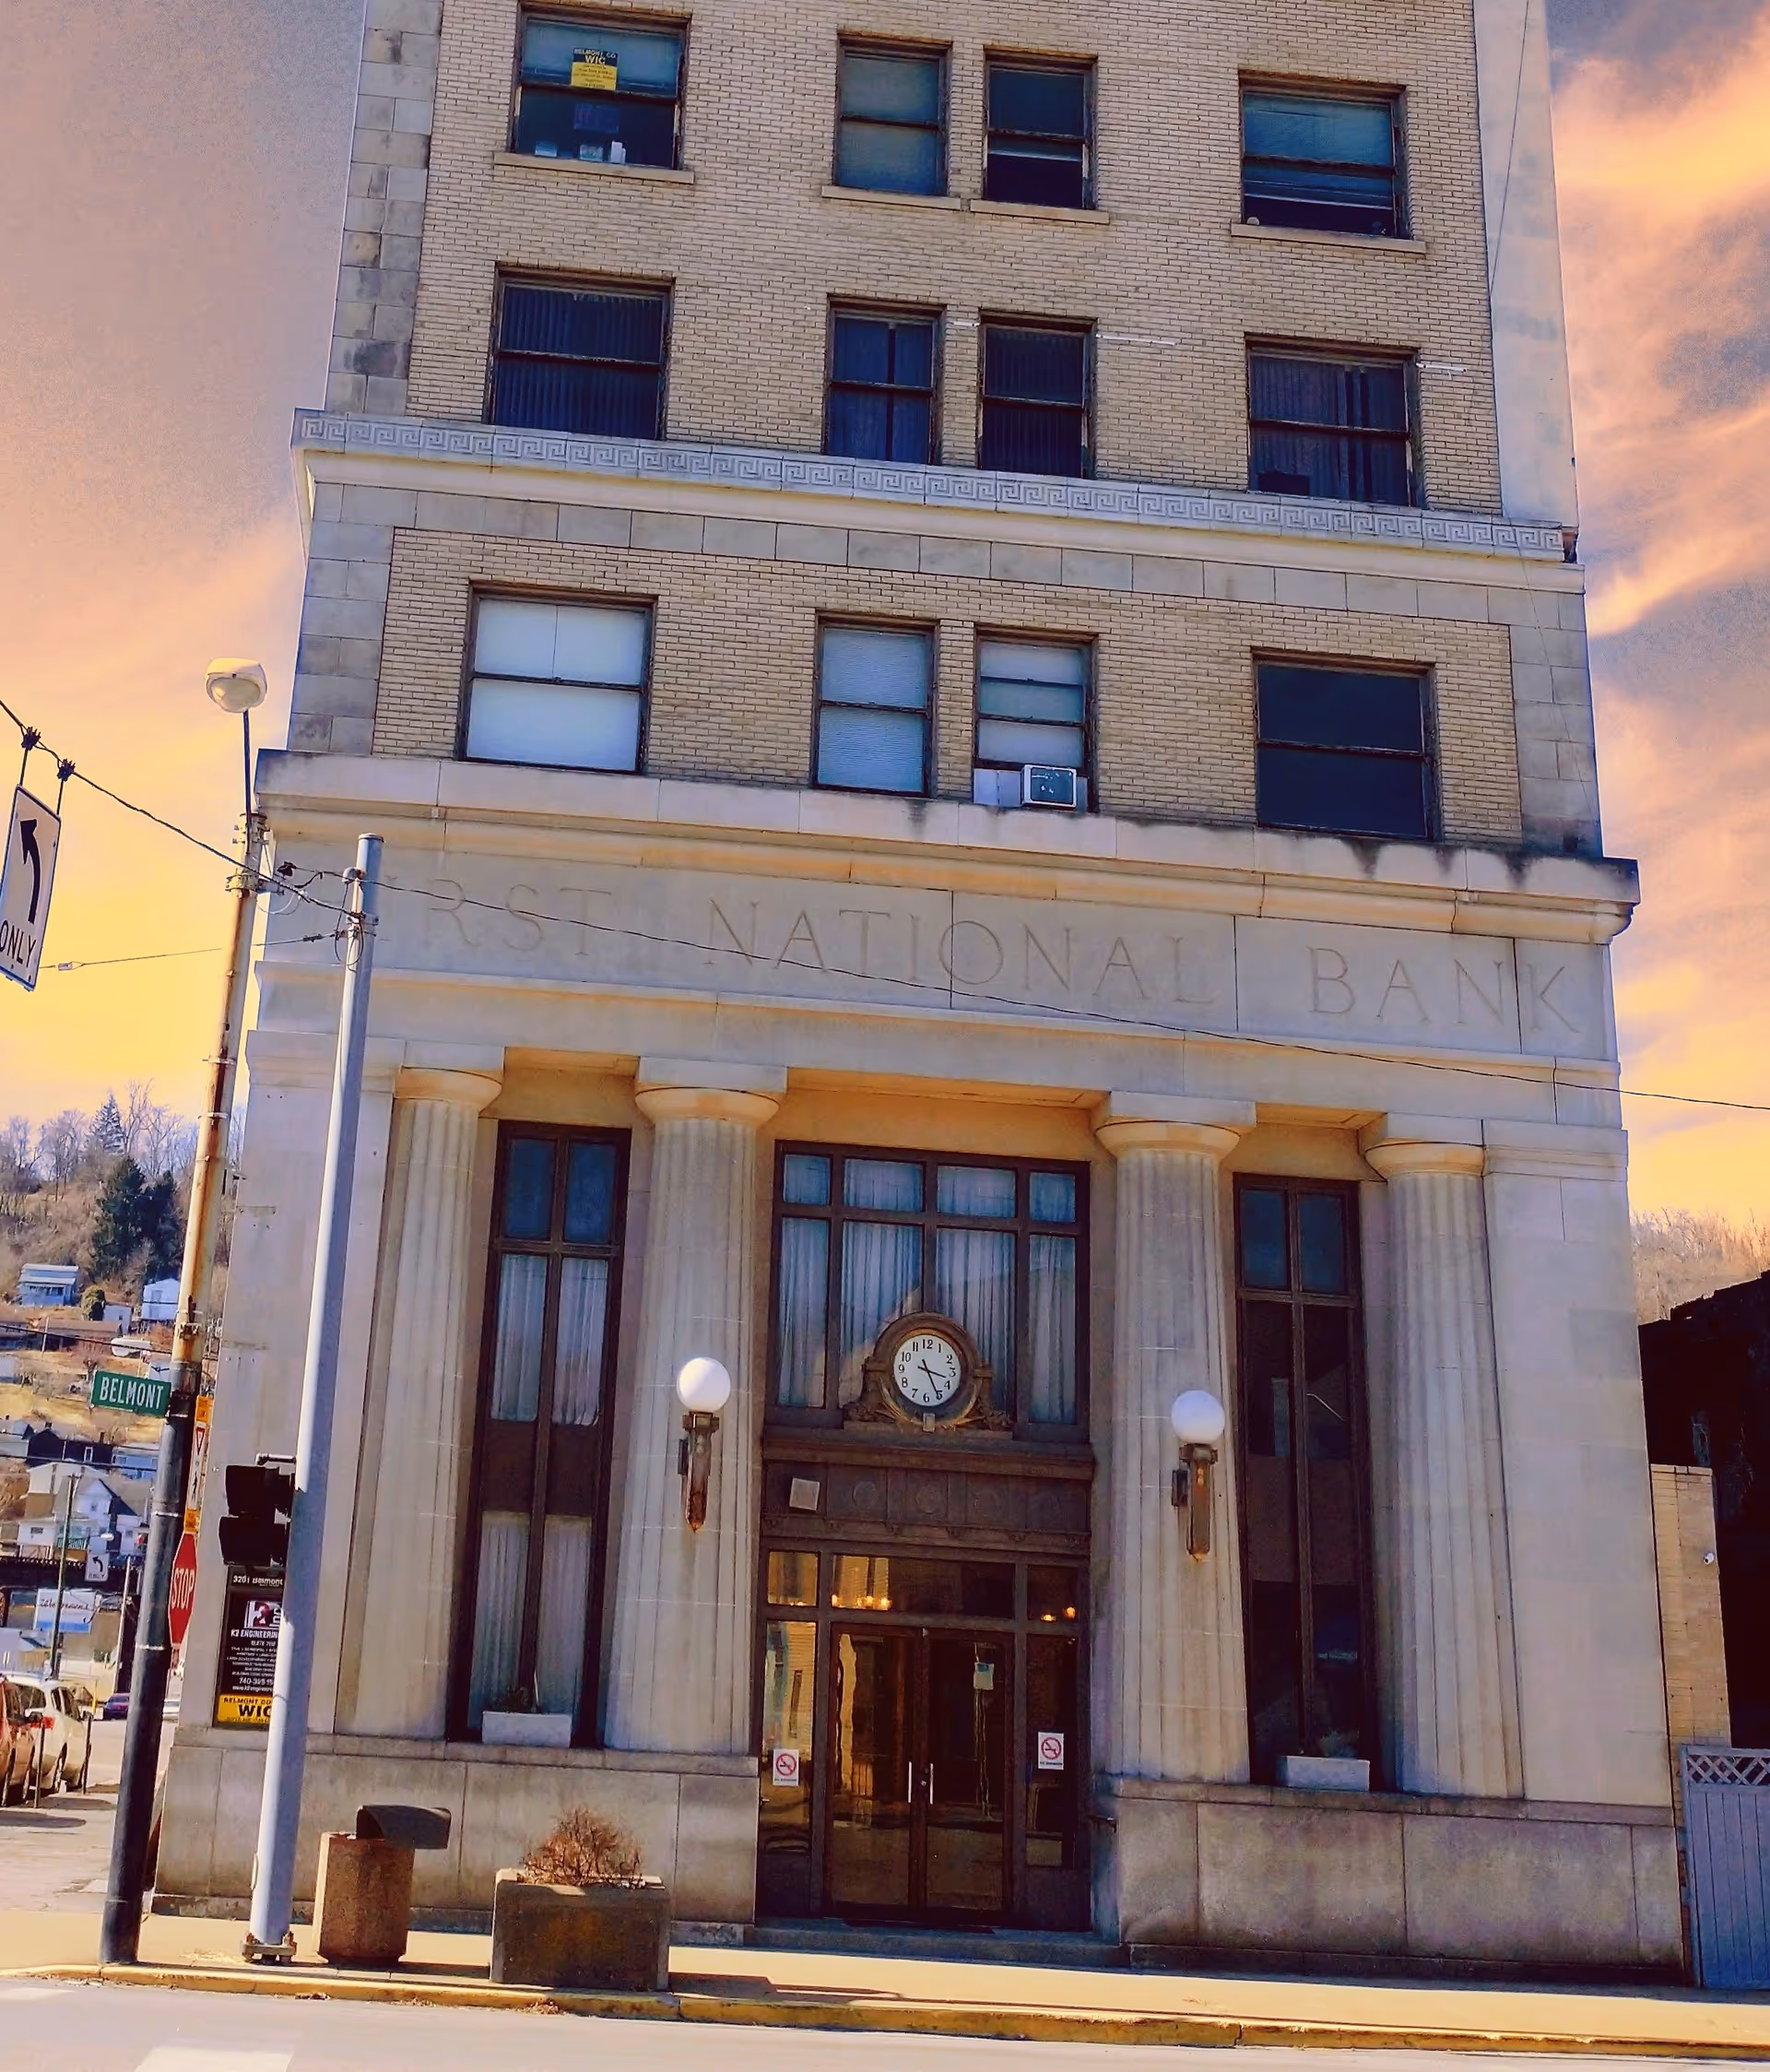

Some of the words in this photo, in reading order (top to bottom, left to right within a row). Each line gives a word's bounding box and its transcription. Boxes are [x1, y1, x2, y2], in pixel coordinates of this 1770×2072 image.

[585, 55, 606, 65] WIC
[0, 920, 36, 967] ONLY
[703, 896, 1215, 1005] NATIONAL
[1306, 945, 1580, 1034] BANK
[913, 1342, 918, 1352] 11
[923, 1339, 933, 1349] 12
[902, 1352, 911, 1362] 10
[947, 1355, 952, 1364] 2
[899, 1365, 904, 1373] 9
[950, 1368, 956, 1377] 3
[902, 1378, 908, 1388] 8
[944, 1380, 950, 1390] 4
[100, 1377, 163, 1409] BELMONT
[912, 1389, 918, 1398] 7
[923, 1392, 929, 1403] 6
[171, 1568, 195, 1609] STOP
